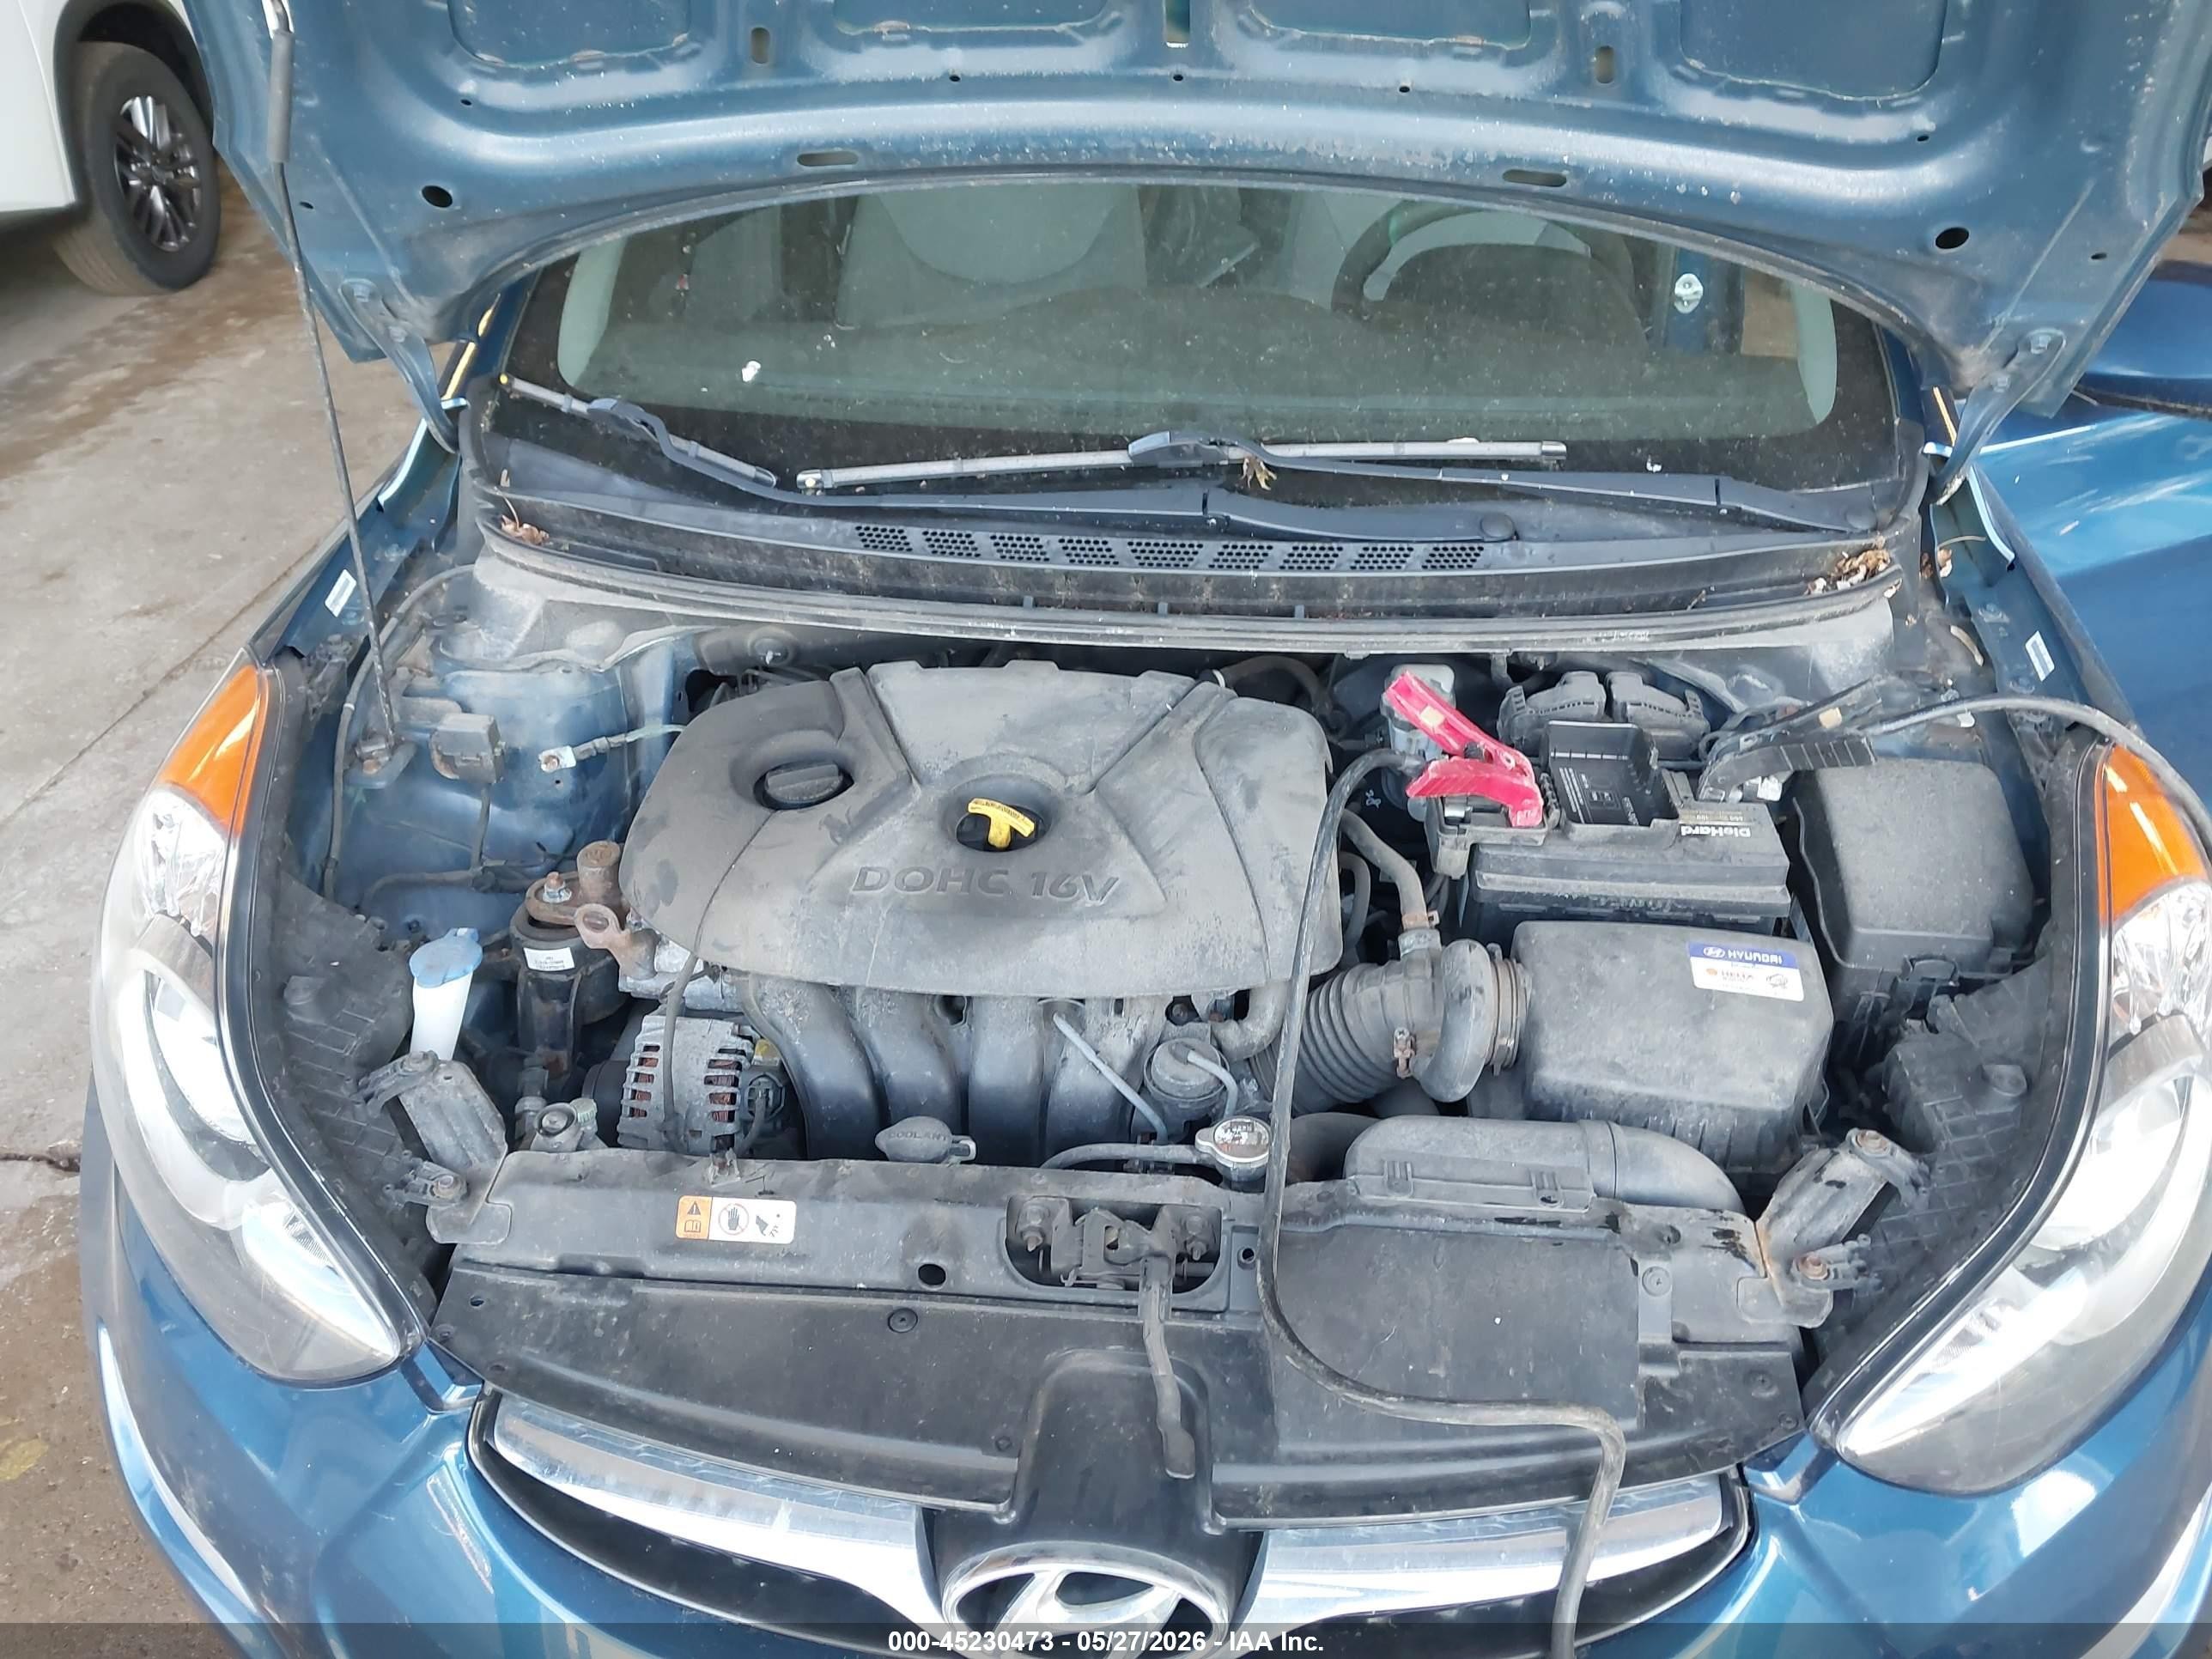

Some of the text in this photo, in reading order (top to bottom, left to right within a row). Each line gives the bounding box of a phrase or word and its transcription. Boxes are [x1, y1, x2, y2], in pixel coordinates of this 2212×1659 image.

[1680, 825, 1751, 838] DieHard
[849, 866, 1120, 906] DOHC 16V
[1728, 949, 1783, 964] HYUNDAI
[888, 1132, 947, 1142] COOLANT
